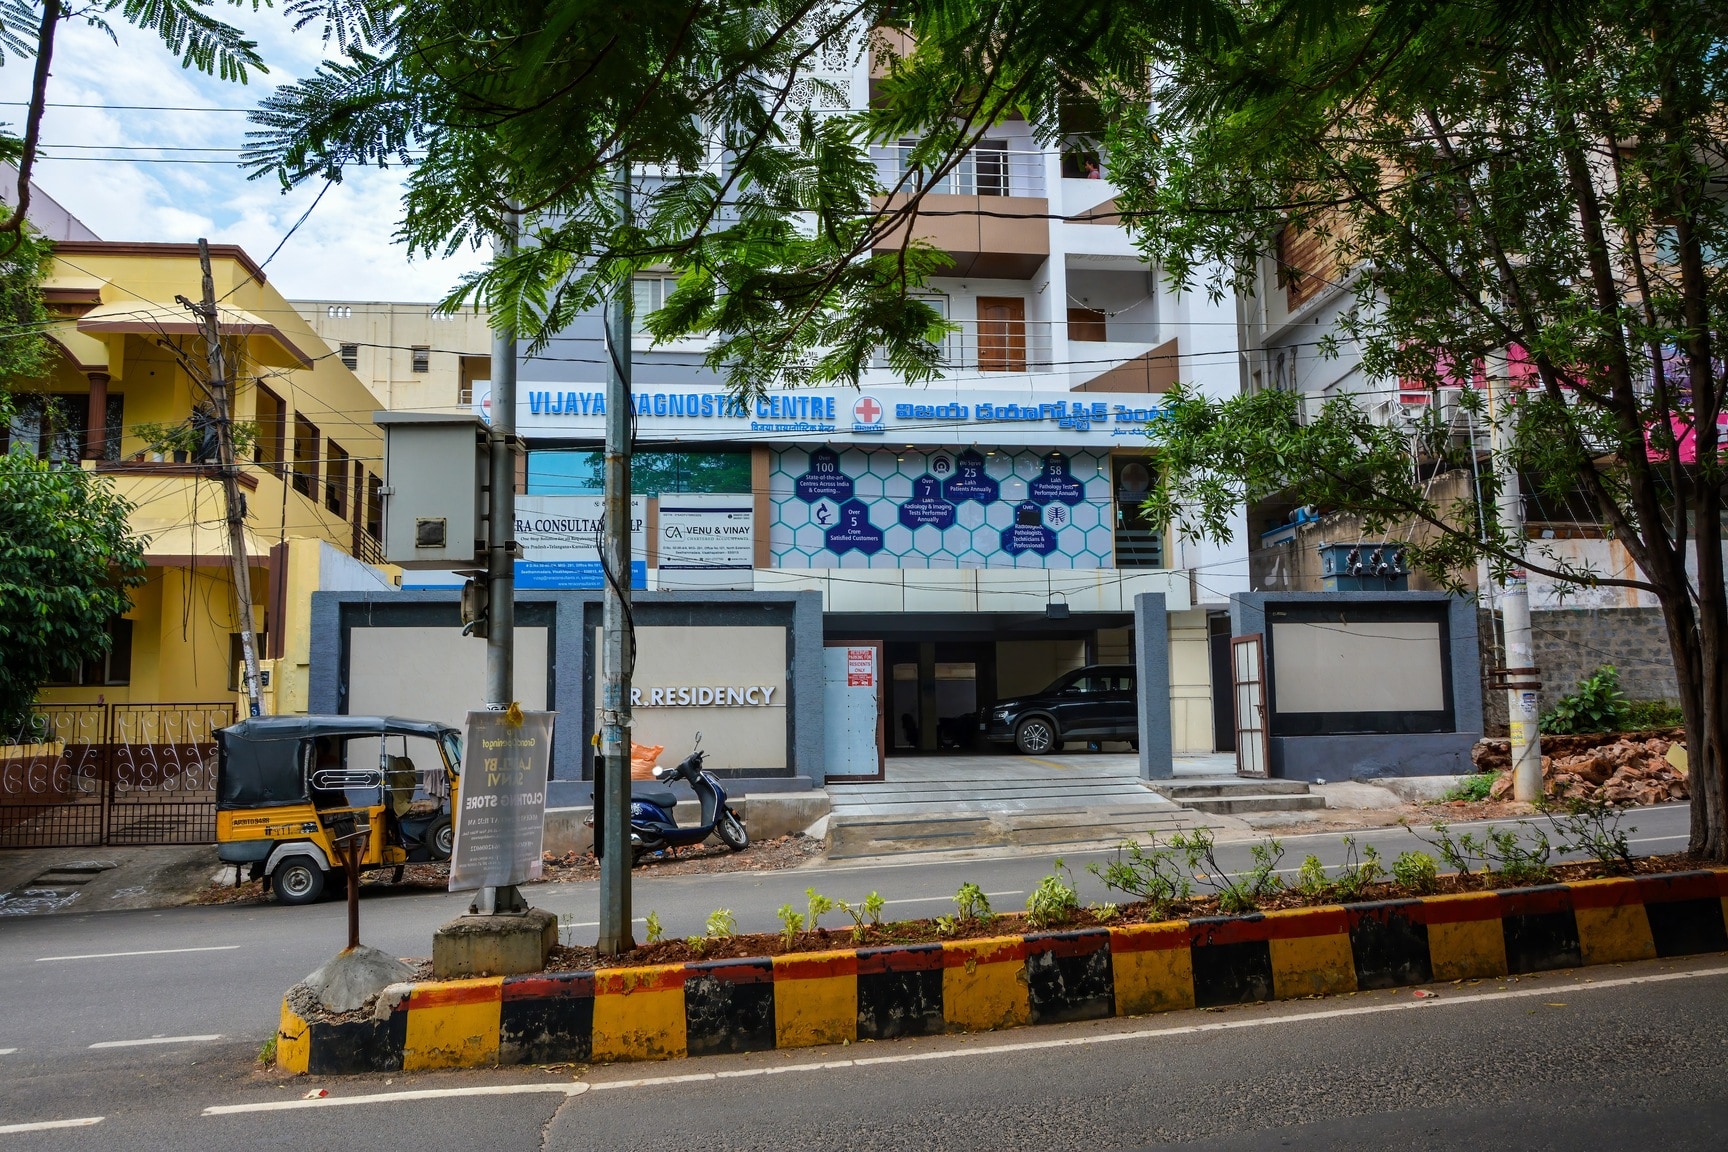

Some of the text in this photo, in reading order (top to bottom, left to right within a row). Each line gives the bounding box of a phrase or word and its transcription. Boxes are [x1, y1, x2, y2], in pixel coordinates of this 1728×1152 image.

[529, 391, 606, 415] VIJAYA
[756, 395, 836, 419] CENTRE
[816, 462, 834, 472] 100
[1049, 466, 1062, 475] 58
[964, 468, 977, 477] 25
[925, 486, 931, 495] 7
[515, 520, 532, 532] RA
[631, 519, 643, 532] LP
[851, 516, 857, 526] 5
[686, 526, 712, 534] VENU
[714, 526, 721, 534] &
[723, 526, 750, 534] VINAY
[631, 686, 776, 706] R.RESIDENCY
